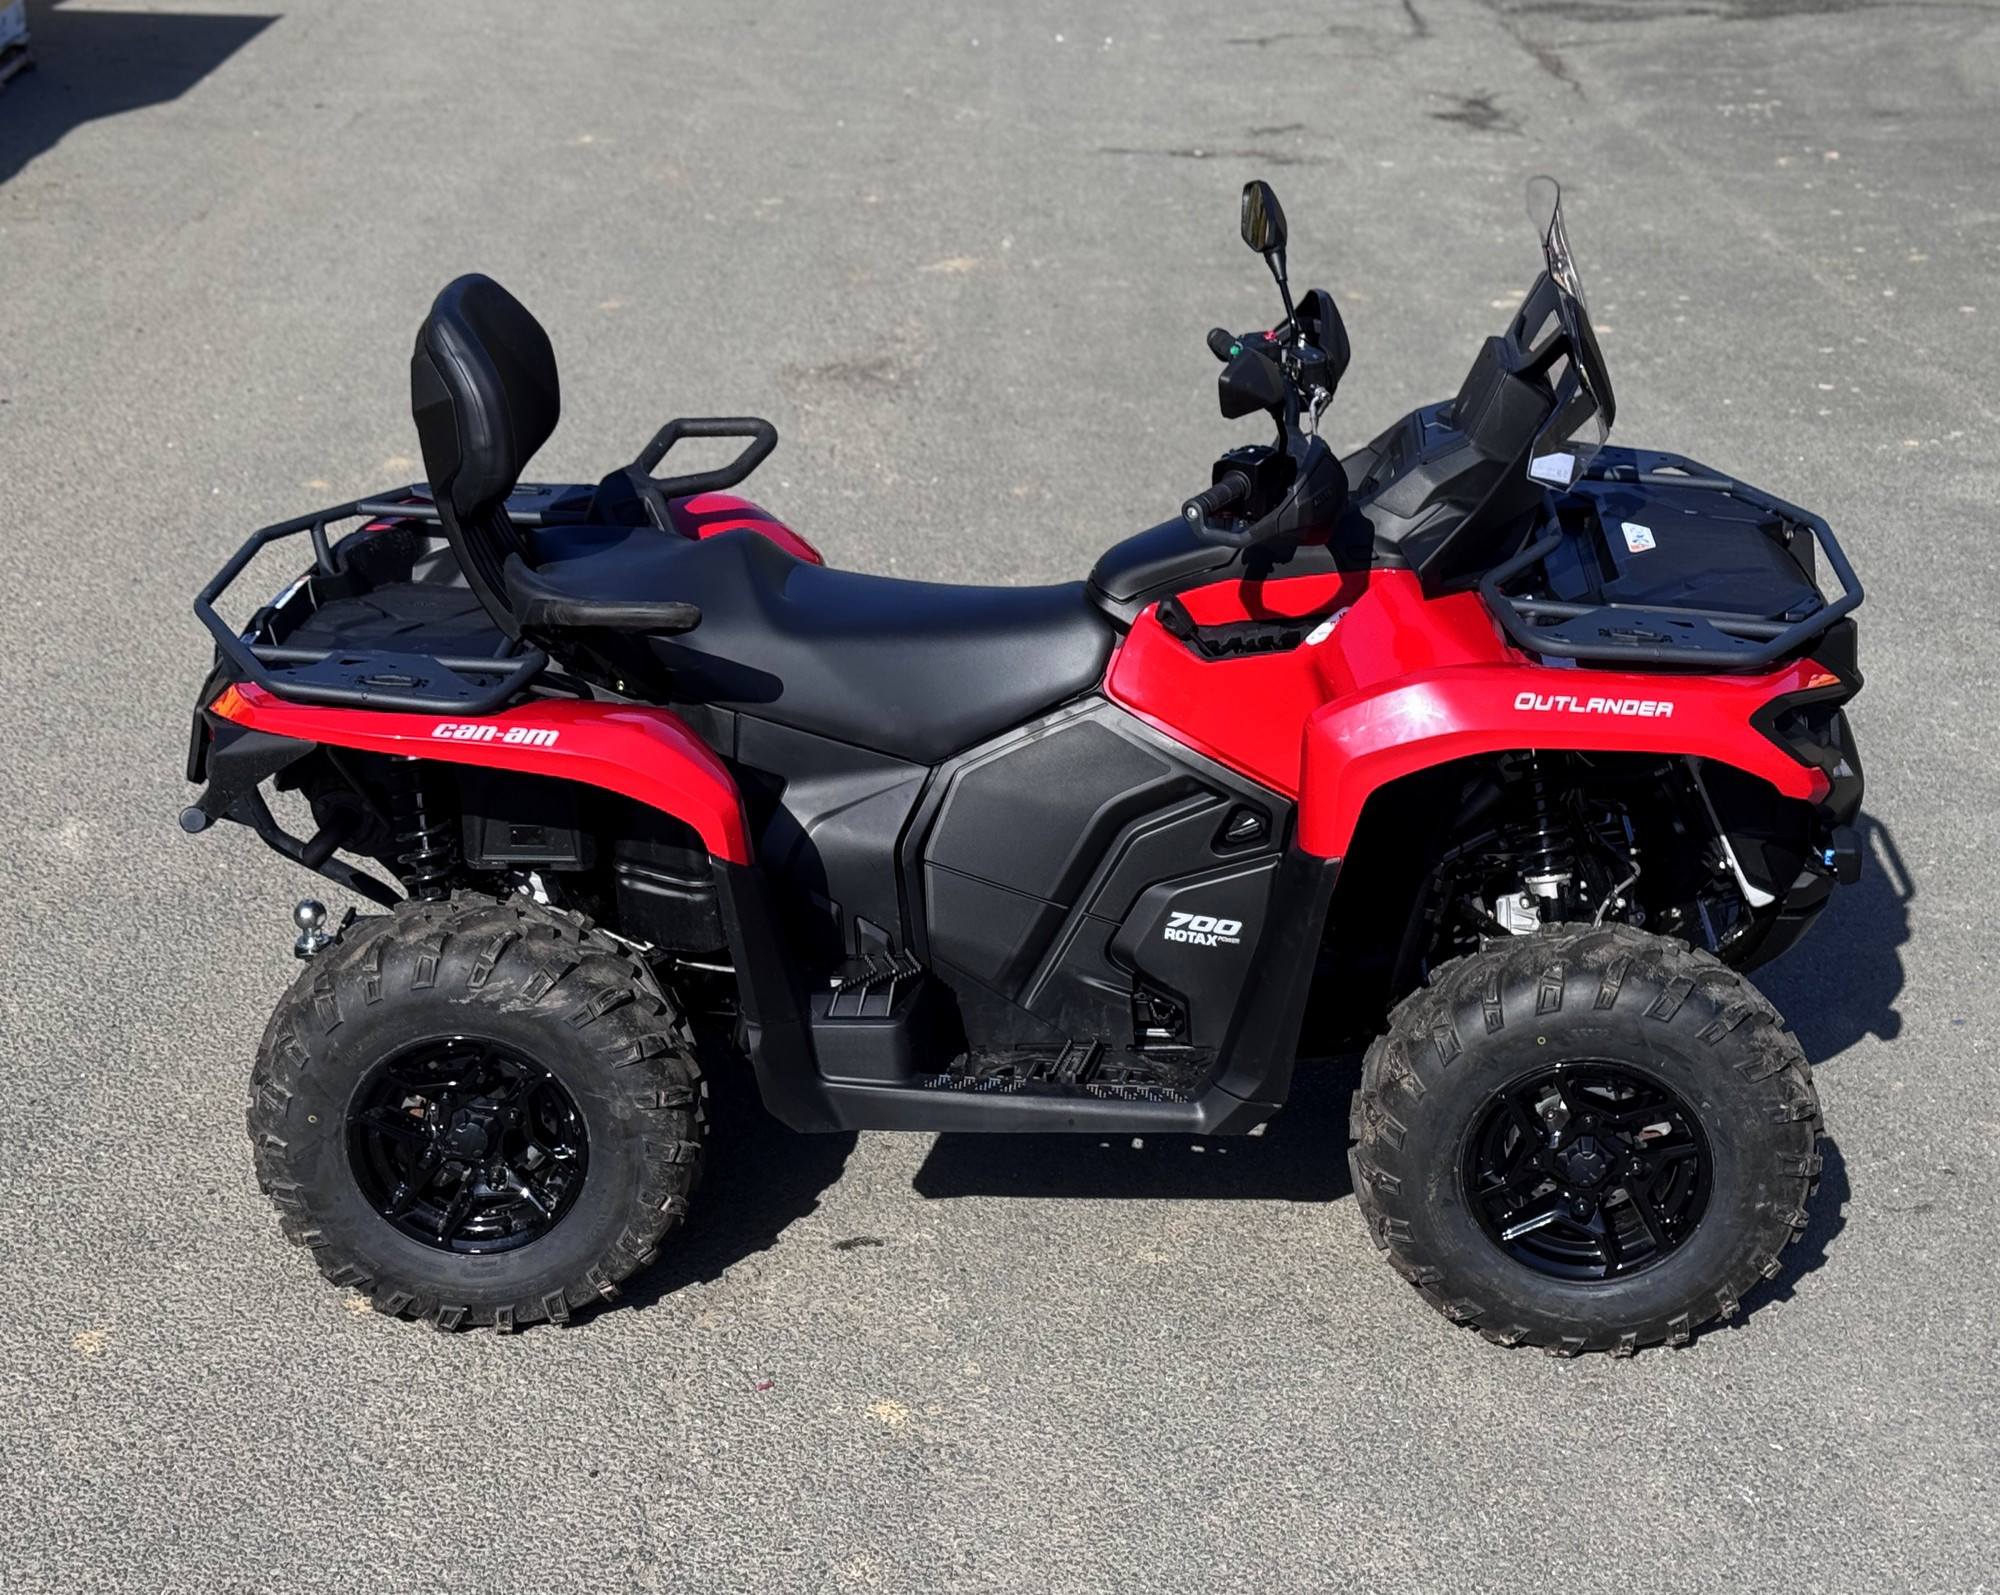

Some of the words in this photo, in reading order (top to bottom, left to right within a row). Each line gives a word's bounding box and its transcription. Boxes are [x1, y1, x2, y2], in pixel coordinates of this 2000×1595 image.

[1514, 692, 1674, 718] OUTLANDER
[431, 723, 560, 746] can-am
[1166, 911, 1242, 936] 700
[1164, 927, 1217, 947] ROTAX
